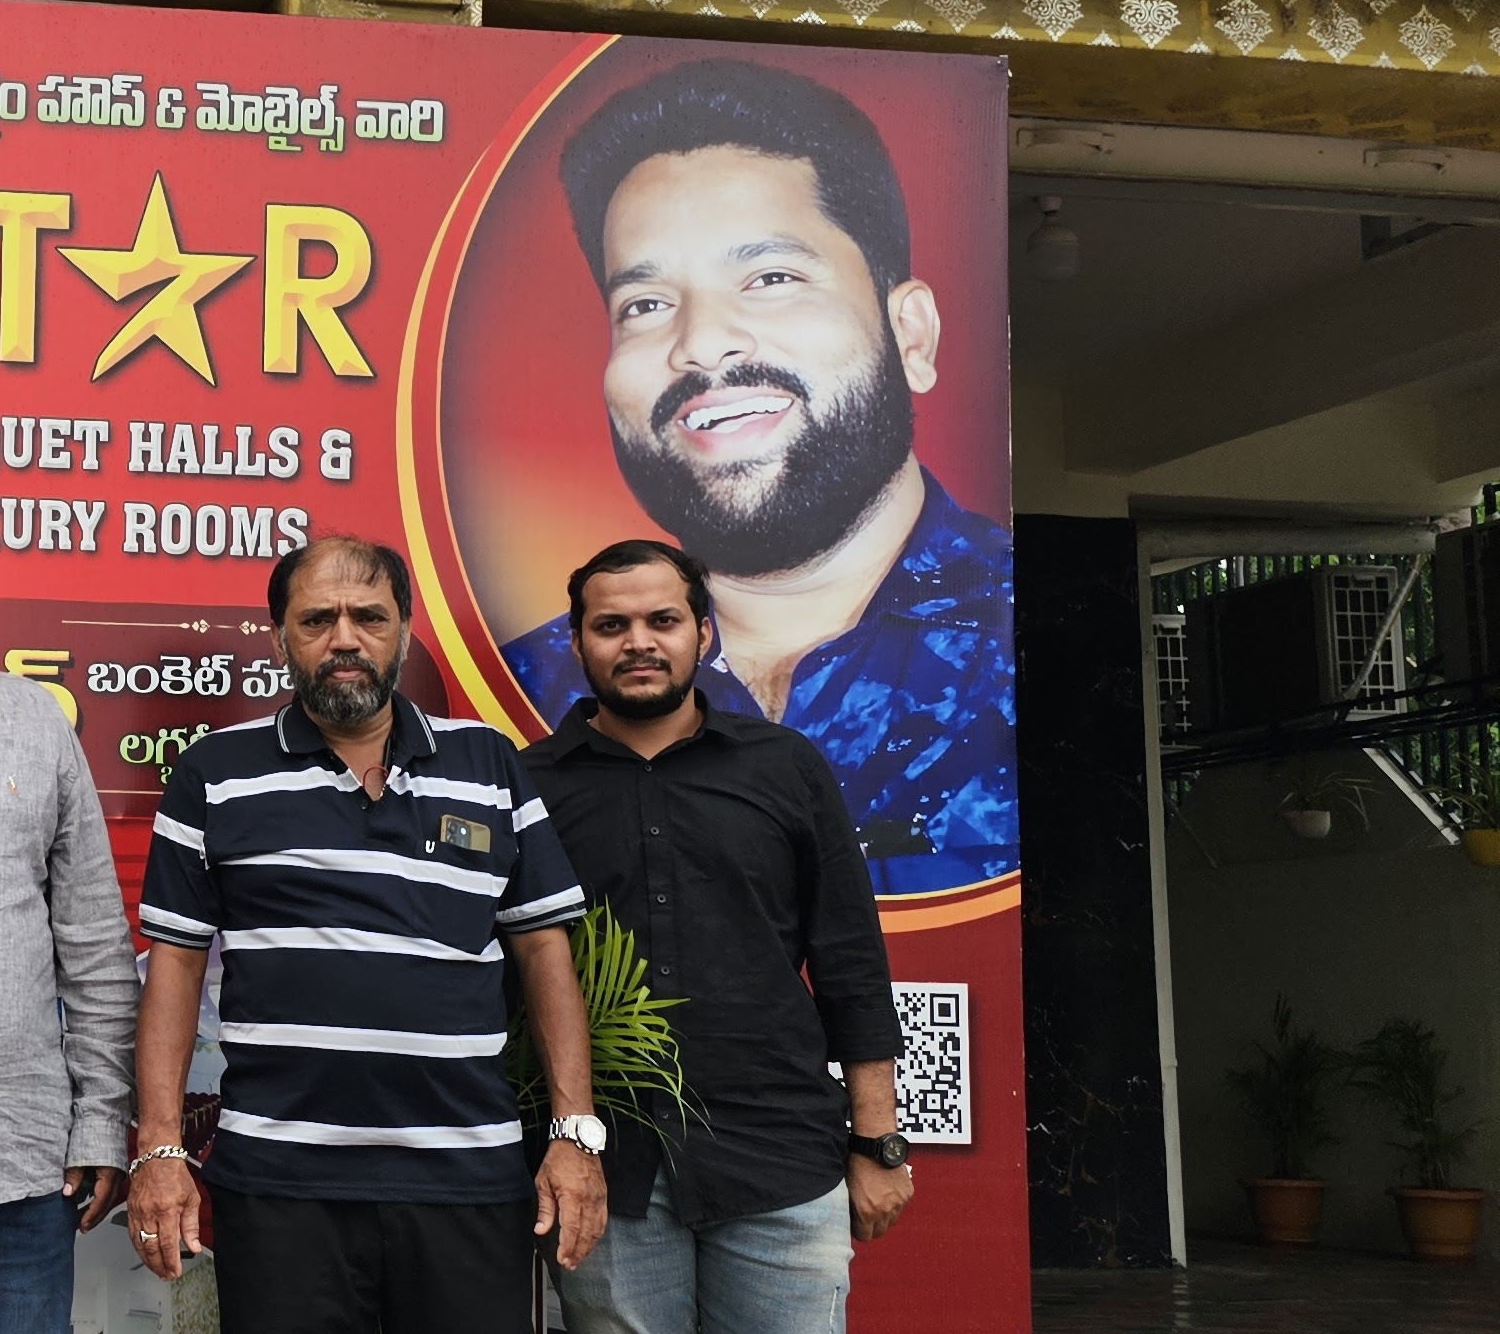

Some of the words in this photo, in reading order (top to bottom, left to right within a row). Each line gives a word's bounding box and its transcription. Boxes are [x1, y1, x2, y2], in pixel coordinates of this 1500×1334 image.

[155, 87, 187, 129] &
[355, 99, 444, 142] వారి
[128, 422, 300, 479] HALLS
[320, 428, 352, 480] &
[123, 501, 309, 556] ROOMS
[87, 654, 234, 696] బంకెట్
